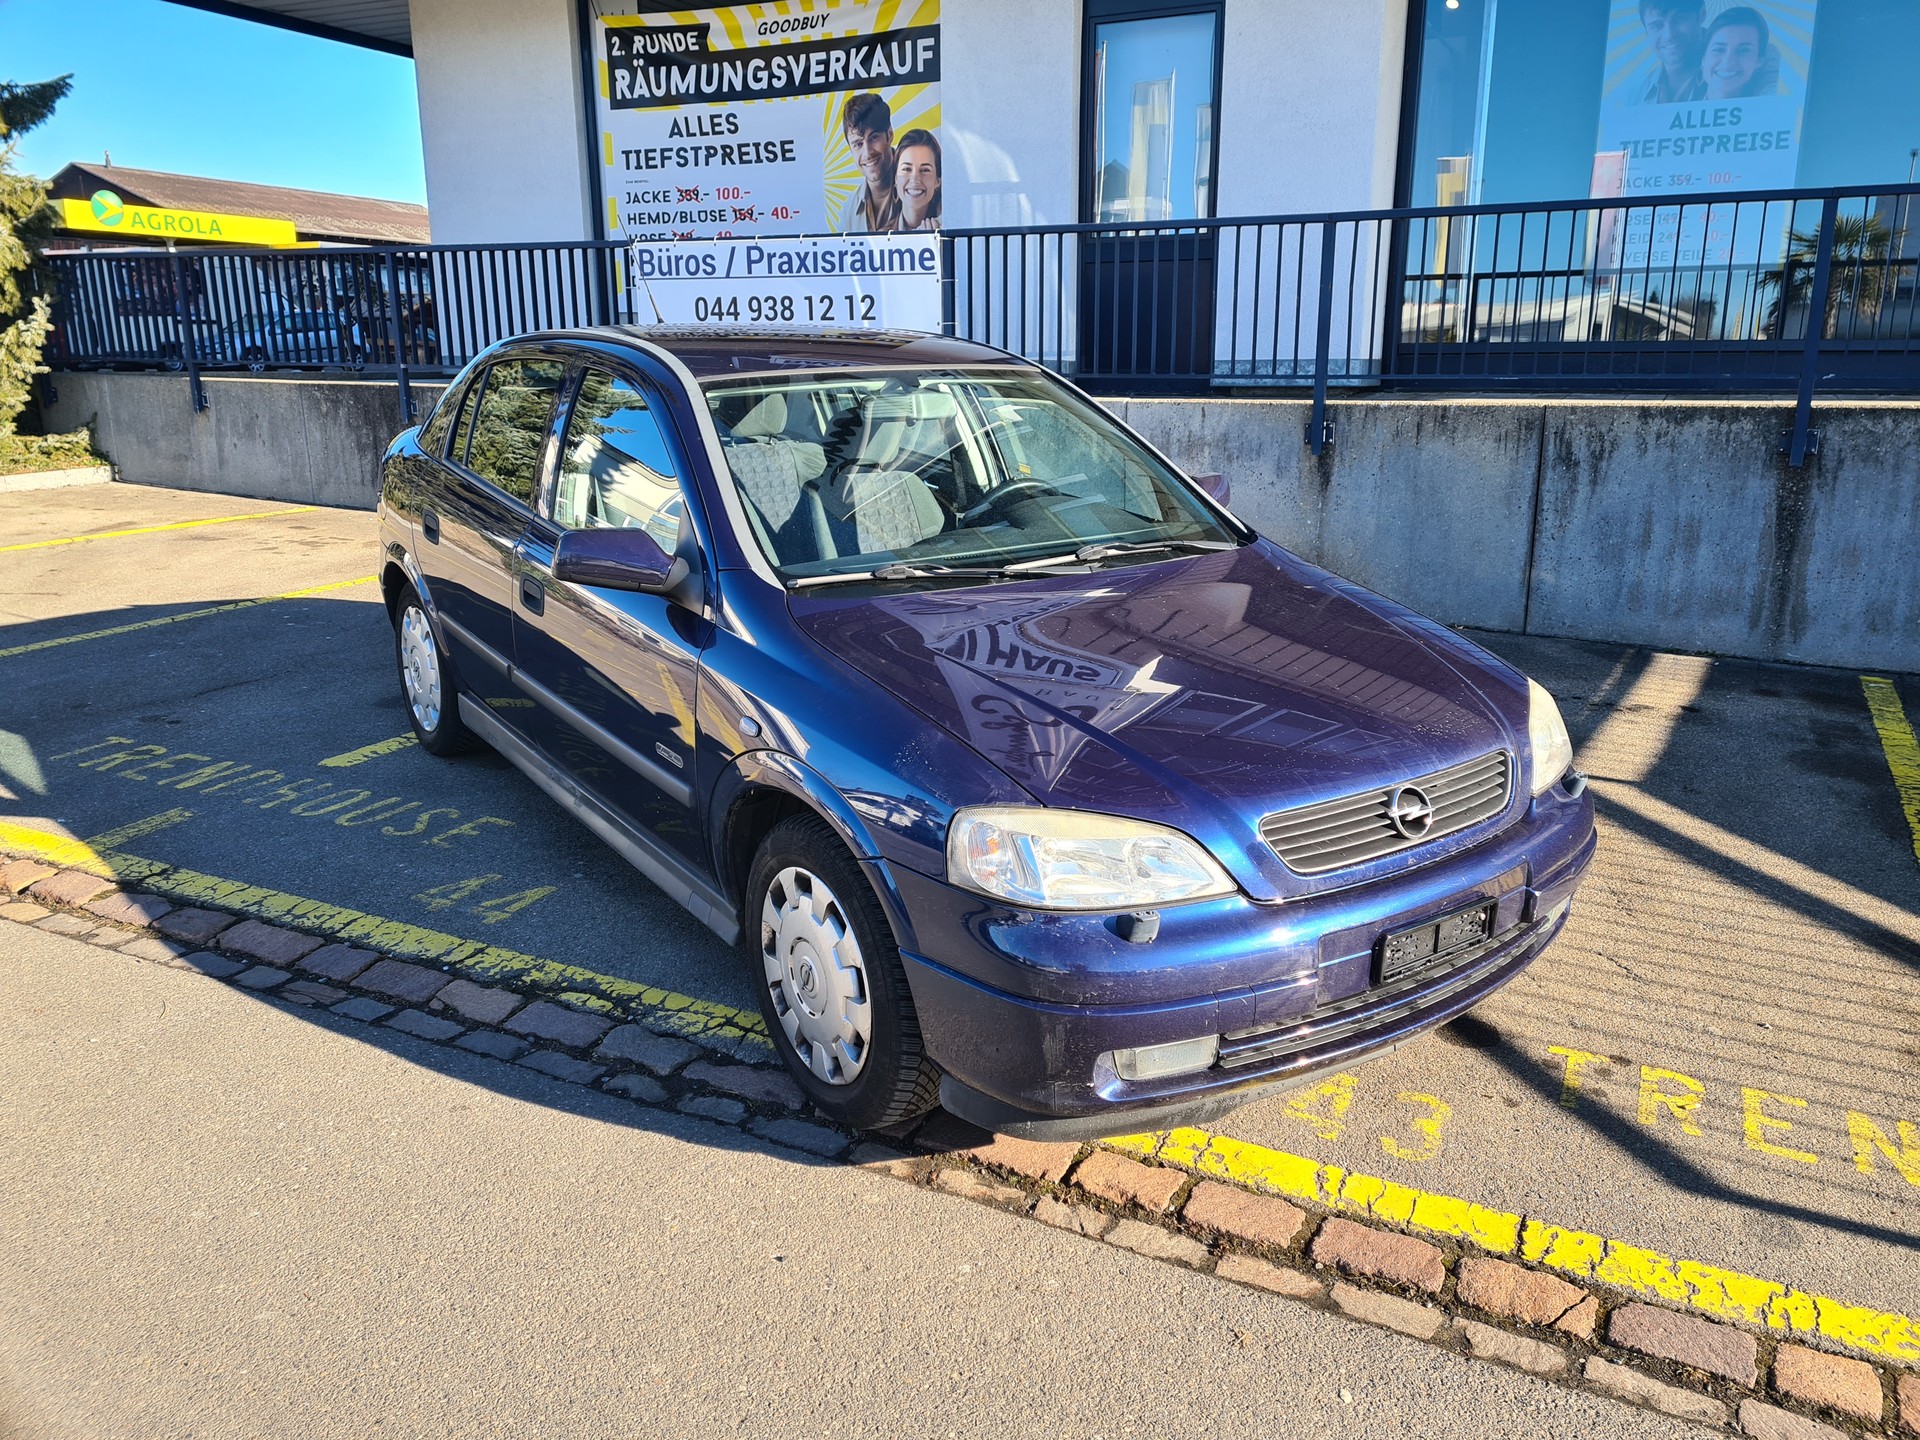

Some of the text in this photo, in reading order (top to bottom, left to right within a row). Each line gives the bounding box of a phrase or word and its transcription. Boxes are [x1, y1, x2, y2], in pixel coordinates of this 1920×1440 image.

[757, 13, 830, 36] GOODBUY
[611, 31, 700, 57] 2. RUNDE
[614, 37, 936, 100] RÄUMUNGSVERKAUF
[668, 112, 740, 139] ALLES
[1669, 106, 1743, 131] ALLES
[621, 139, 797, 171] TIEFSTPREISE
[1619, 130, 1792, 161] TIEFSTPREISE
[1617, 176, 1663, 190] JACKE
[1708, 172, 1742, 185] 100.-
[626, 189, 671, 205] JACKE
[715, 186, 751, 201] 100.-
[131, 211, 223, 236] AGROLA
[627, 208, 728, 226] HEMD/BLUSE
[770, 206, 801, 220] 40.-
[638, 247, 718, 277] Büros
[725, 246, 736, 279] /
[746, 241, 937, 277] Praxisräume
[1677, 249, 1713, 262] EILE
[694, 293, 877, 323] 044 938 12 12
[50, 735, 518, 849] TRENDHOUSE
